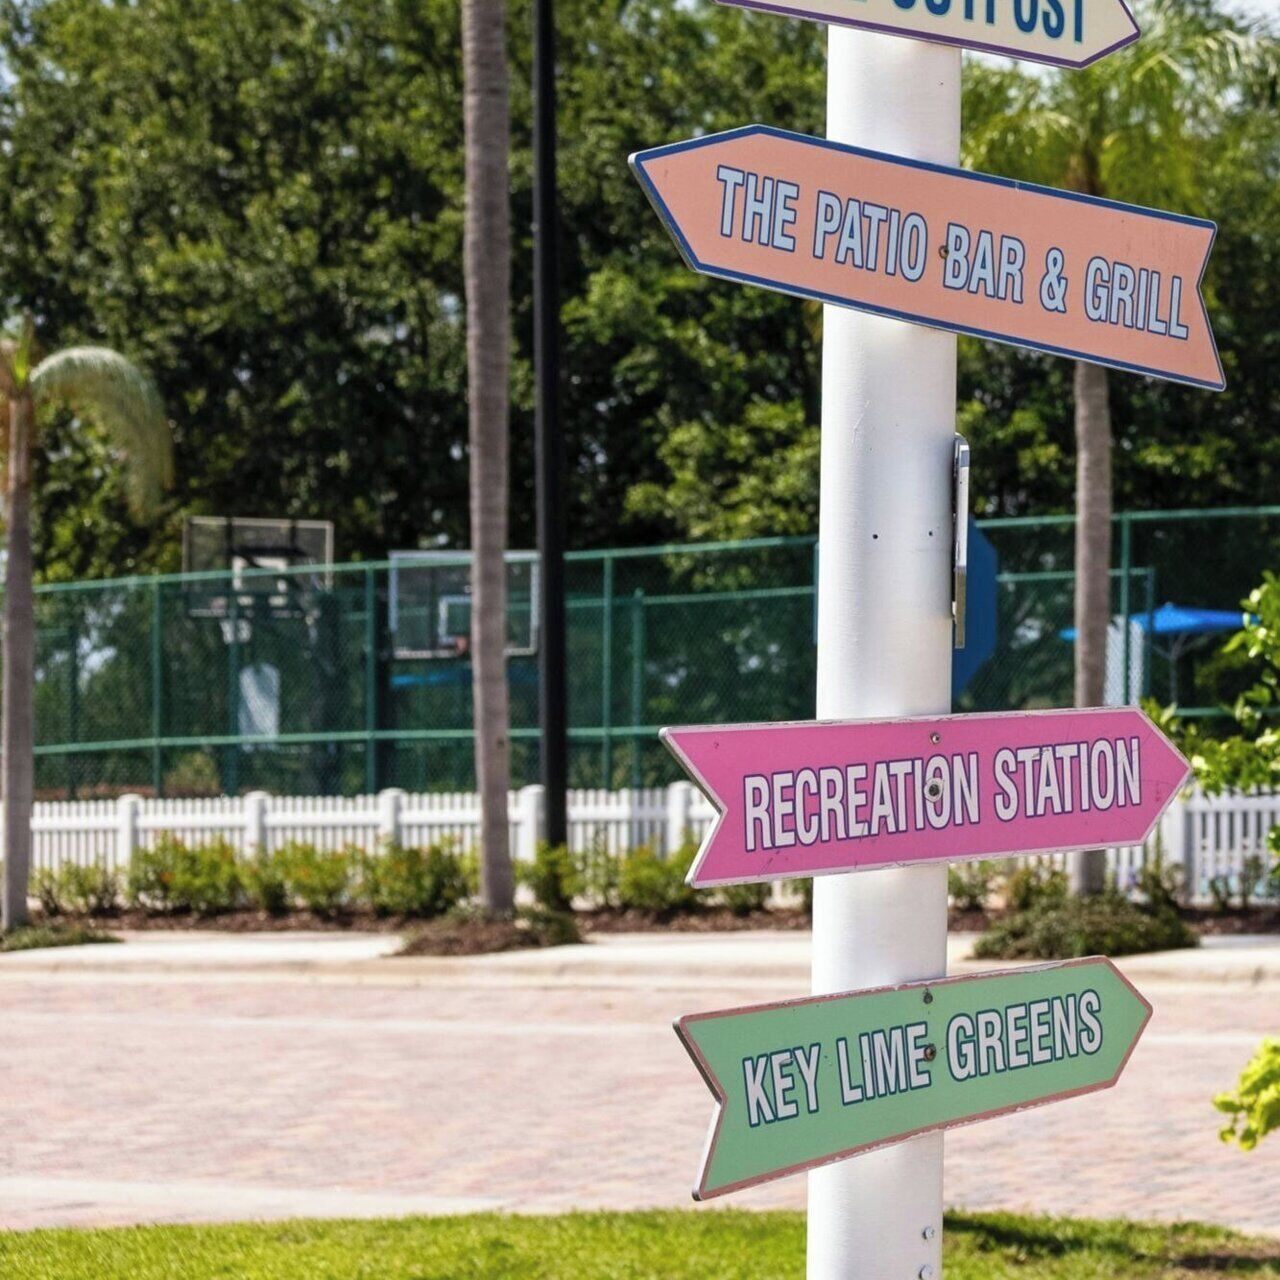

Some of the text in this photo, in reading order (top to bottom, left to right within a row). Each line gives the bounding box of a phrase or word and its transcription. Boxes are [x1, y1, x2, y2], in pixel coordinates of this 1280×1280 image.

[716, 165, 1190, 341] THE PATIO BAR & GRILL
[742, 736, 1142, 852] RECREATION STATION
[742, 988, 1102, 1127] KEY LIME GREENS
